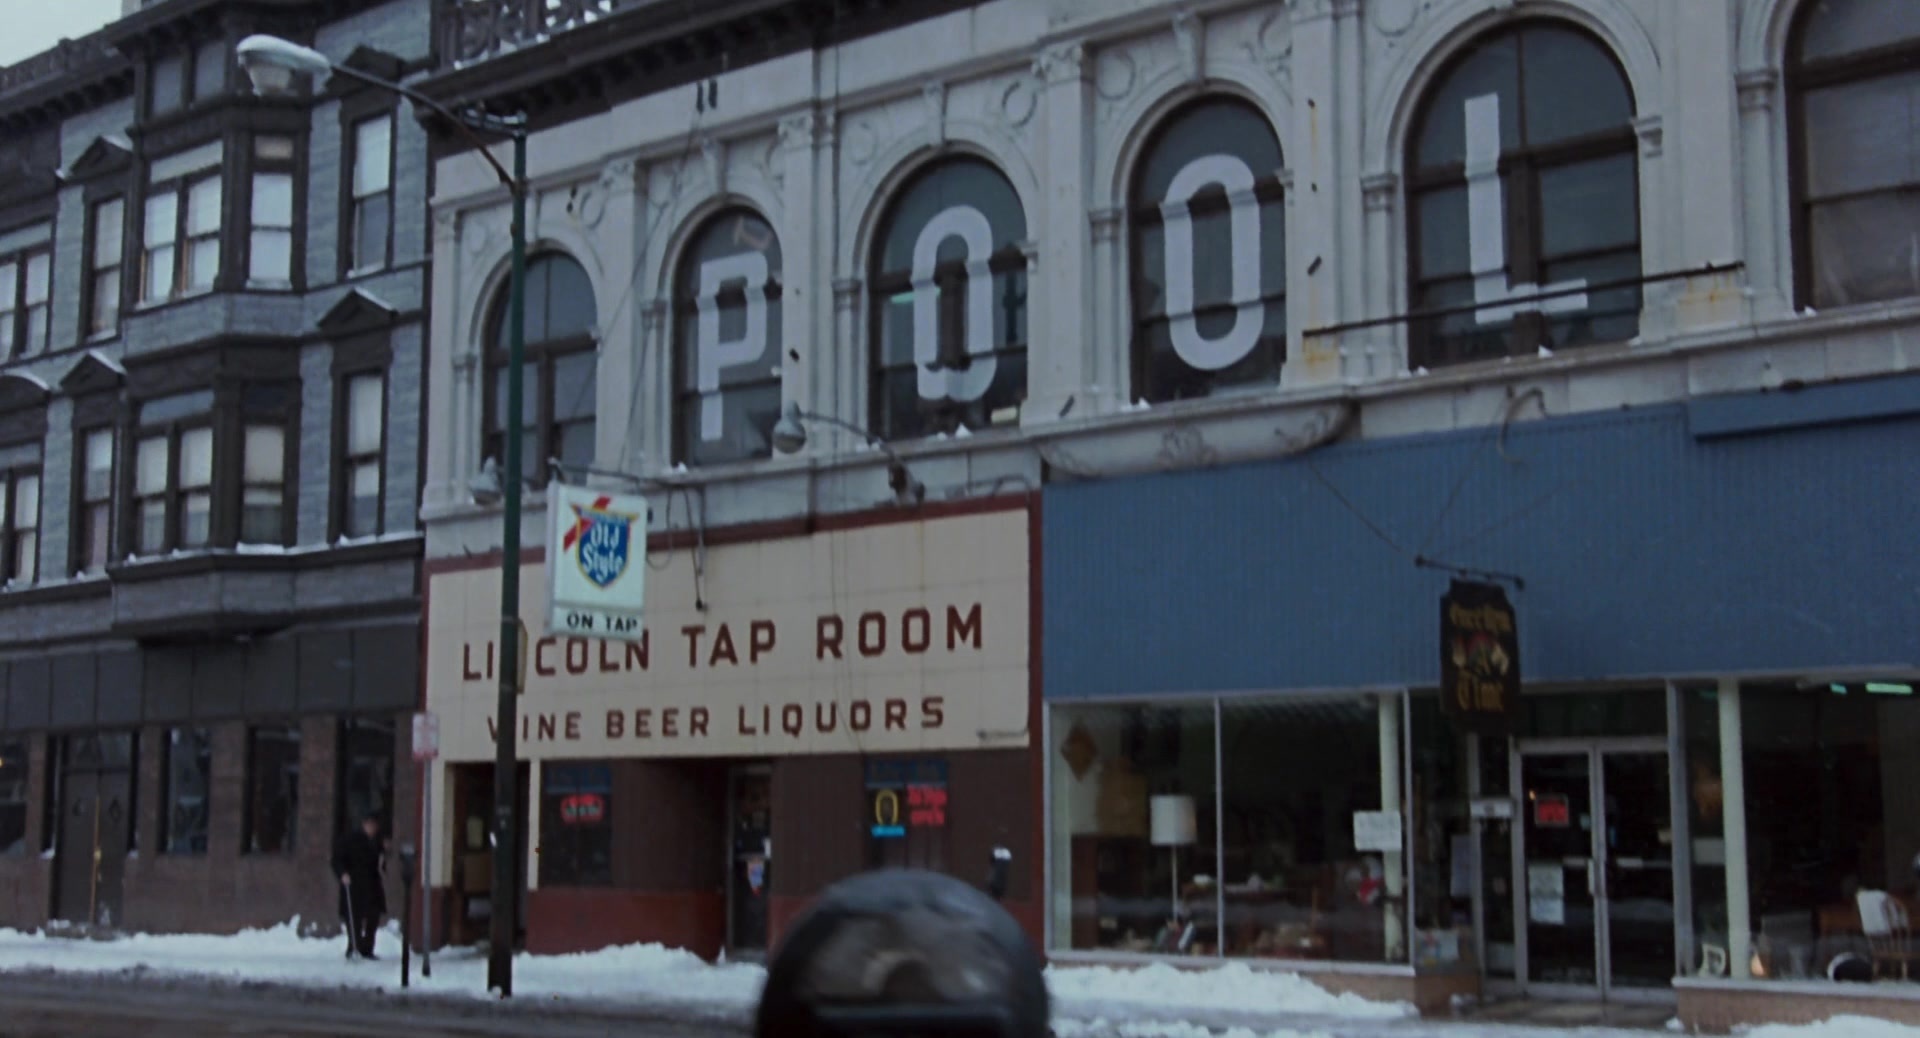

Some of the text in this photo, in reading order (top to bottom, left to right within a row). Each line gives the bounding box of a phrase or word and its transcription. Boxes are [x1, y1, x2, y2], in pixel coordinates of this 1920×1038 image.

[590, 521, 620, 549] Old
[583, 541, 625, 584] Style
[462, 602, 982, 681] LICOLN TAP ROOM
[567, 612, 638, 633] ON TAP
[606, 706, 709, 739] BEER
[738, 696, 944, 738] LIQUORS
